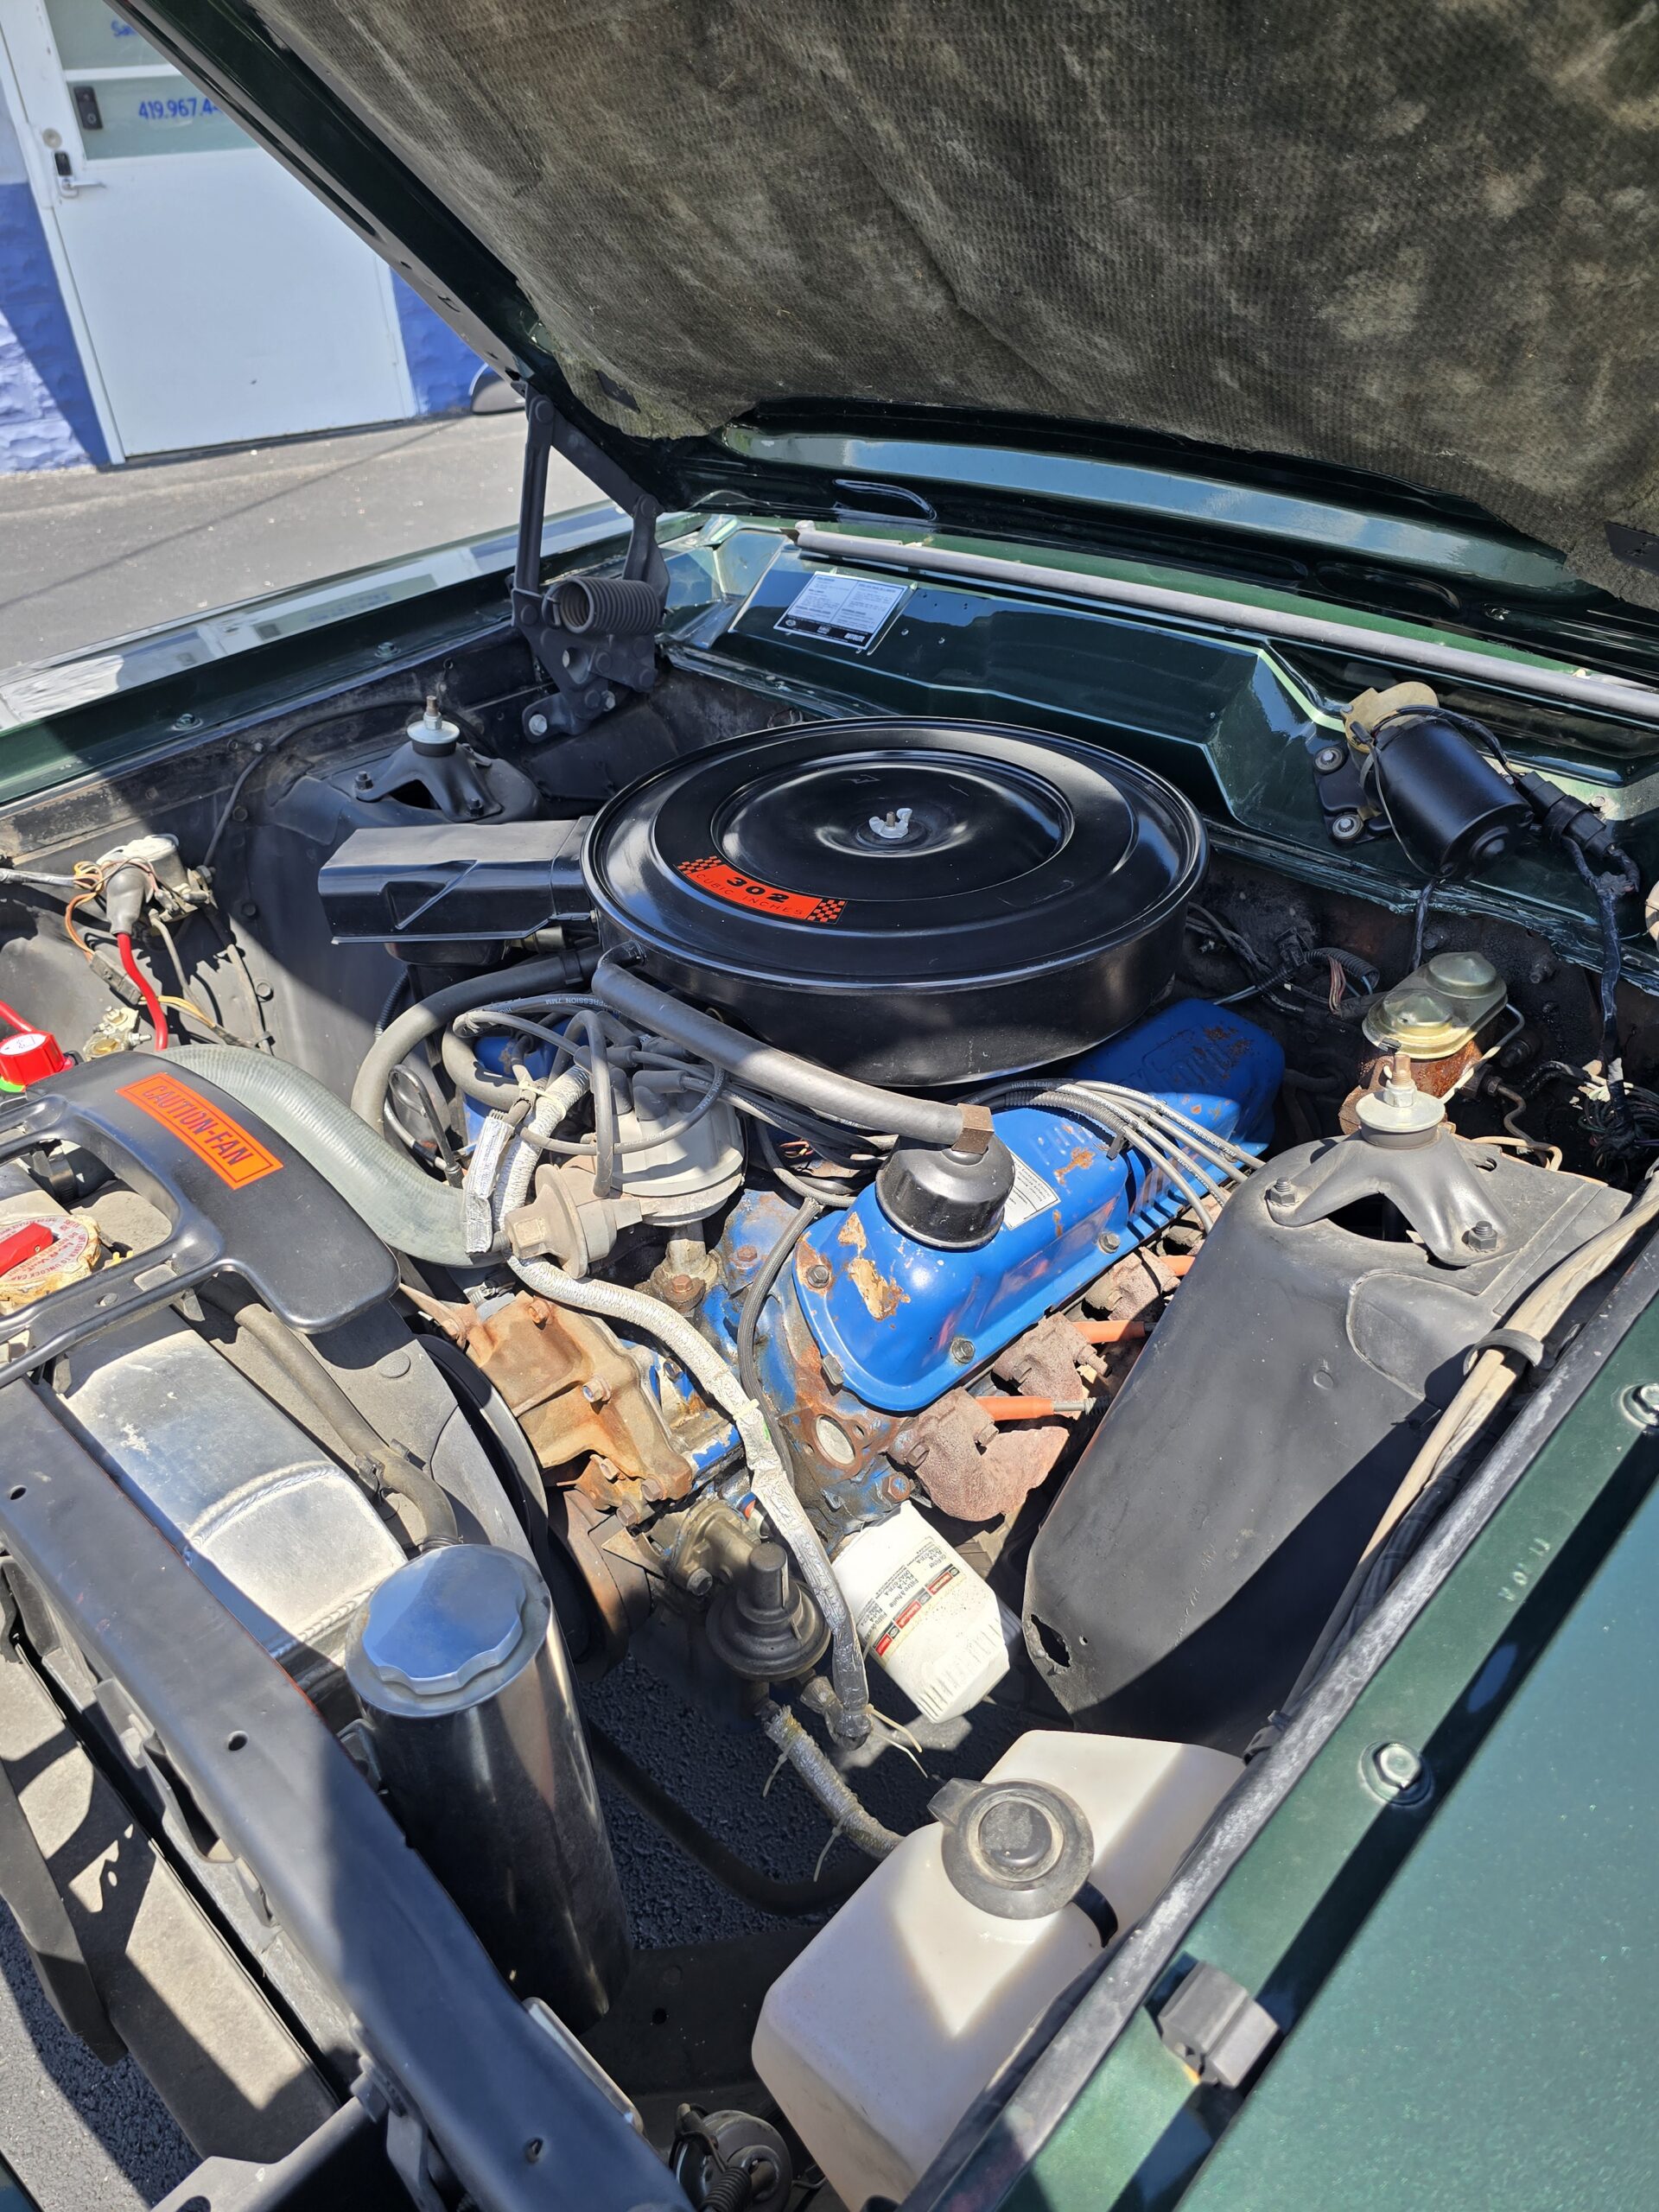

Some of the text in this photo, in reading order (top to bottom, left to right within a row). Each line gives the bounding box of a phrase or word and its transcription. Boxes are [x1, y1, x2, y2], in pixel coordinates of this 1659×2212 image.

[696, 873, 804, 916] CUBIC INCHES
[726, 876, 790, 904] 302
[1011, 1081, 1030, 1090] HIGH
[142, 1084, 255, 1166] CAUTION-FAN
[1177, 1117, 1222, 1148] SUPPRESSION
[29, 1262, 61, 1279] UNLOCK
[897, 1573, 914, 1591] FL-1-A
[903, 1577, 919, 1593] Filtre
[888, 1593, 904, 1609] huile
